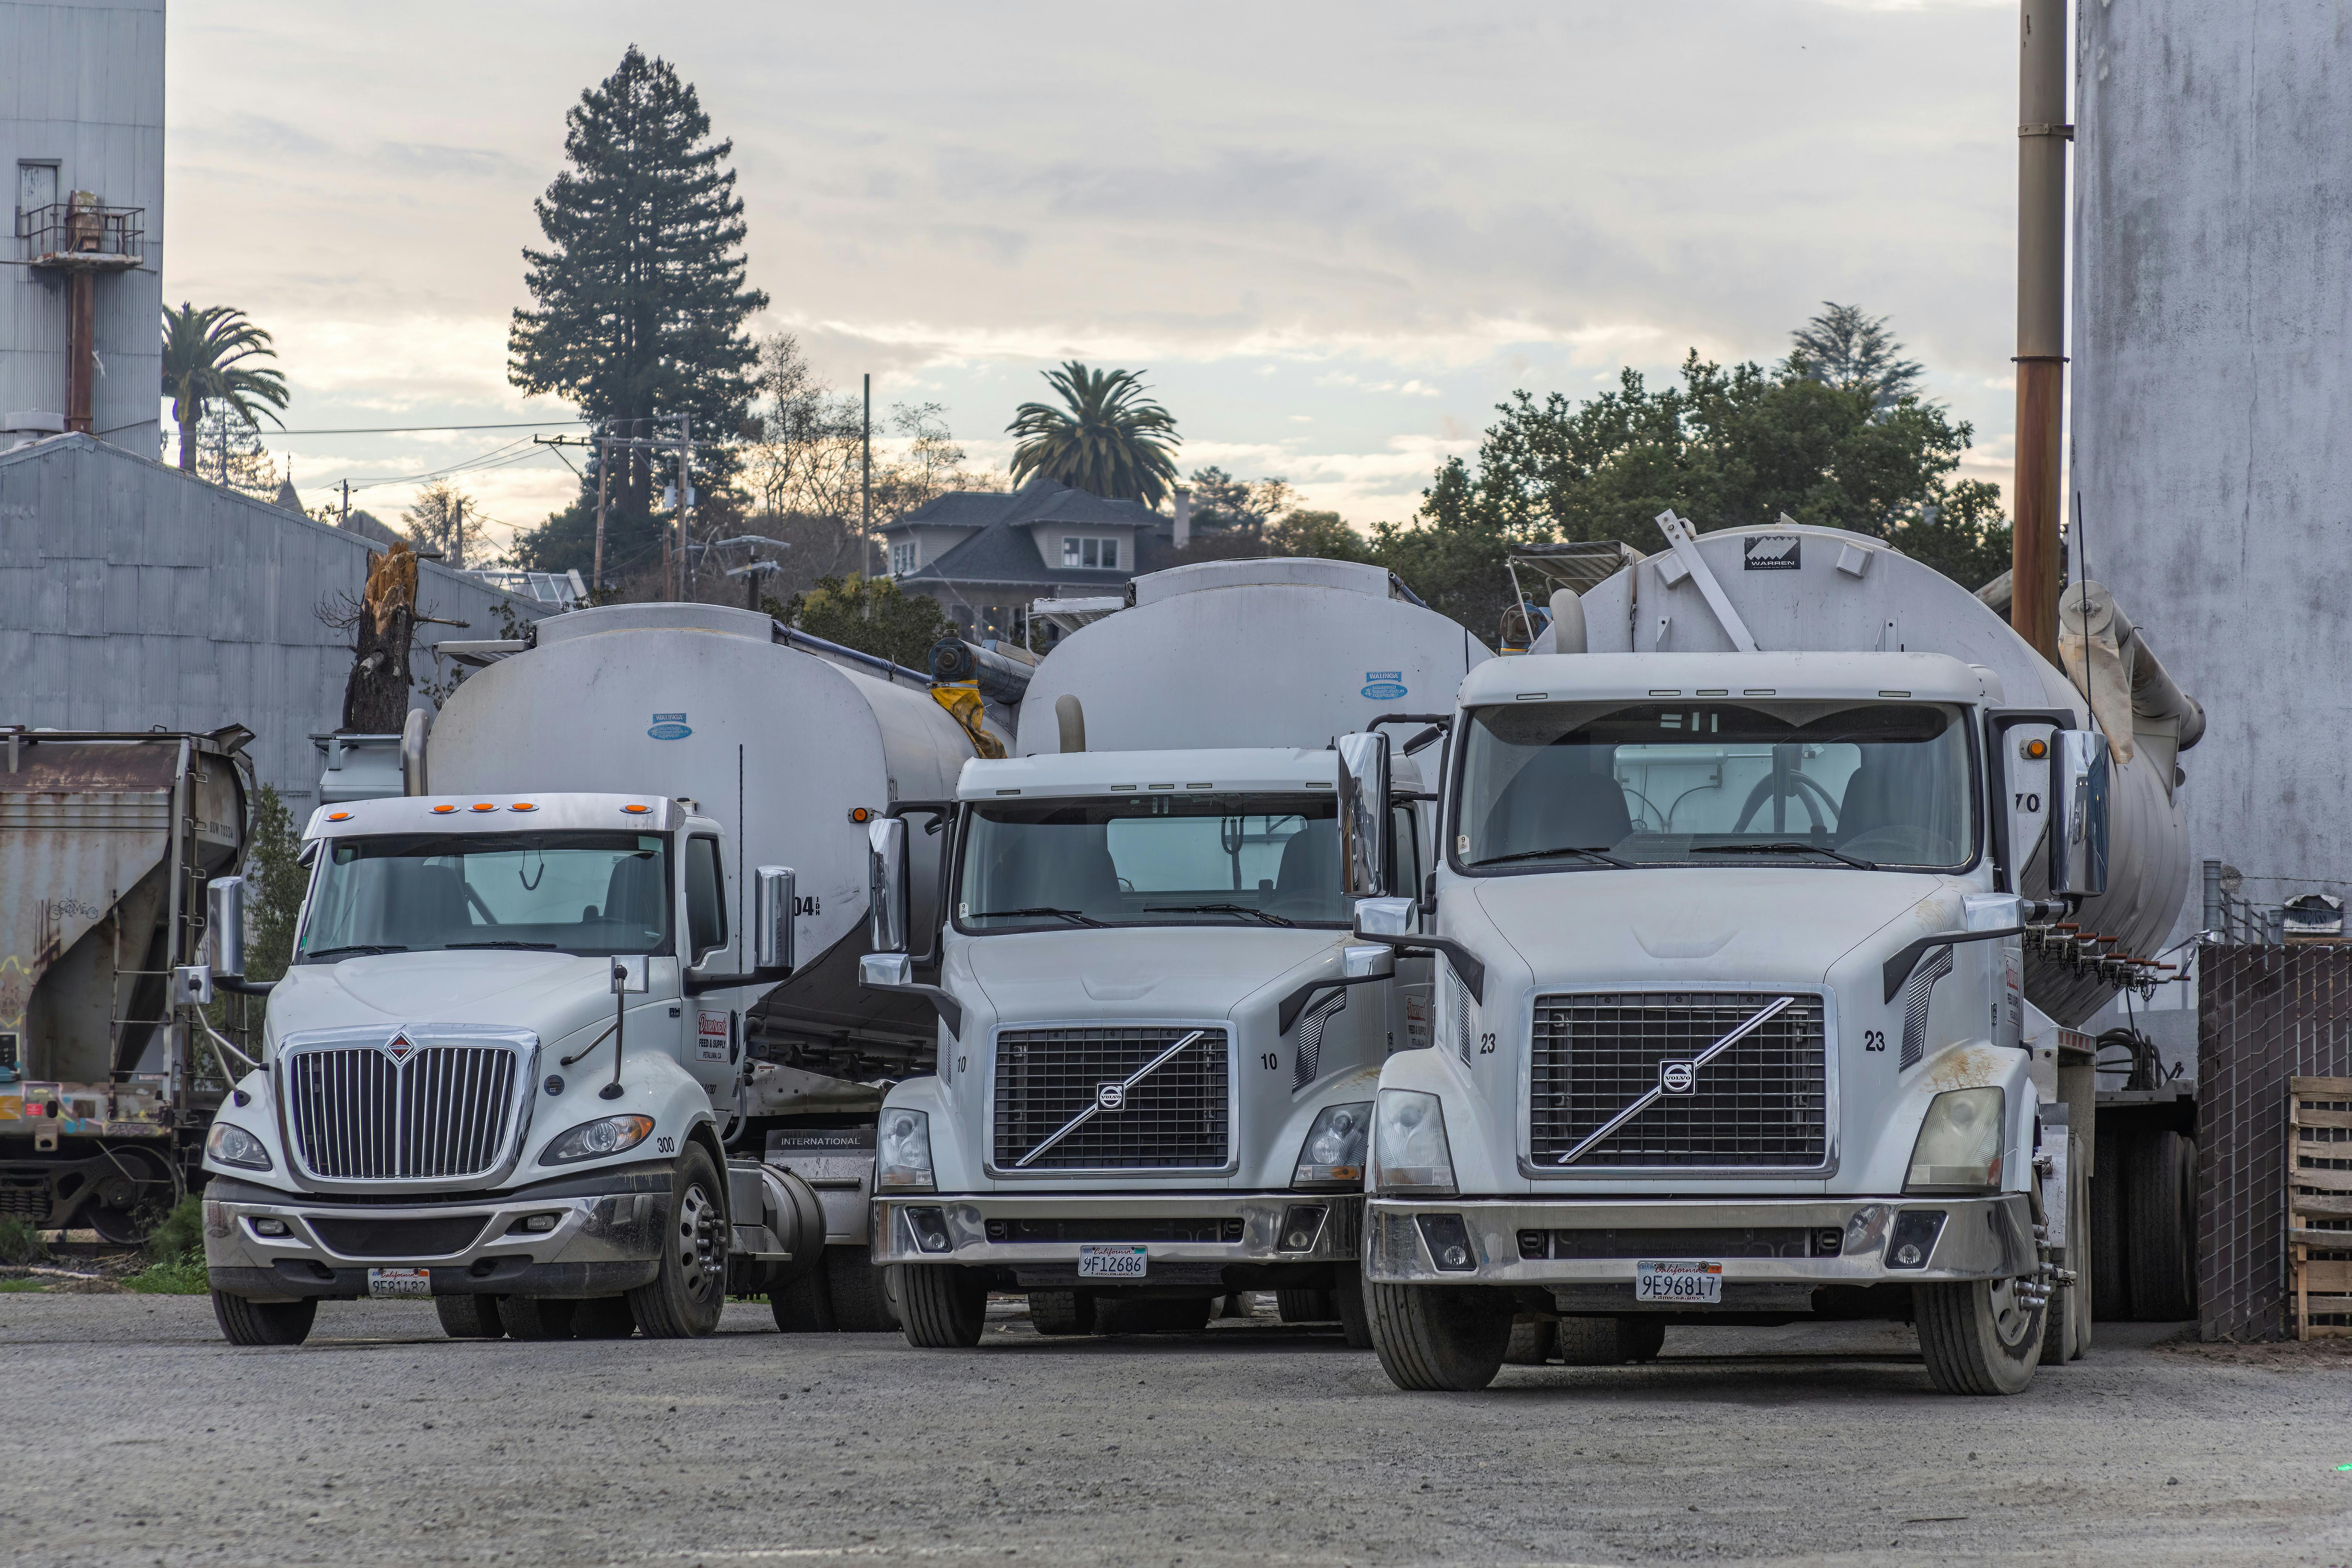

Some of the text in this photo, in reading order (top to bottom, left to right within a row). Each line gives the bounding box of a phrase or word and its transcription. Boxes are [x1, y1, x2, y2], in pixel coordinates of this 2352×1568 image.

[699, 1038, 709, 1047] FEED
[713, 1039, 726, 1049] SUPPLY
[1481, 1033, 1496, 1054] 23
[1865, 1030, 1885, 1052] 23
[958, 1056, 966, 1073] 10
[1261, 1053, 1277, 1070] 10
[657, 1136, 674, 1153] 300
[1093, 1247, 1135, 1256] California
[1083, 1256, 1142, 1272] 9F12686
[1655, 1263, 1701, 1276] California
[1642, 1276, 1715, 1296] 9E96817
